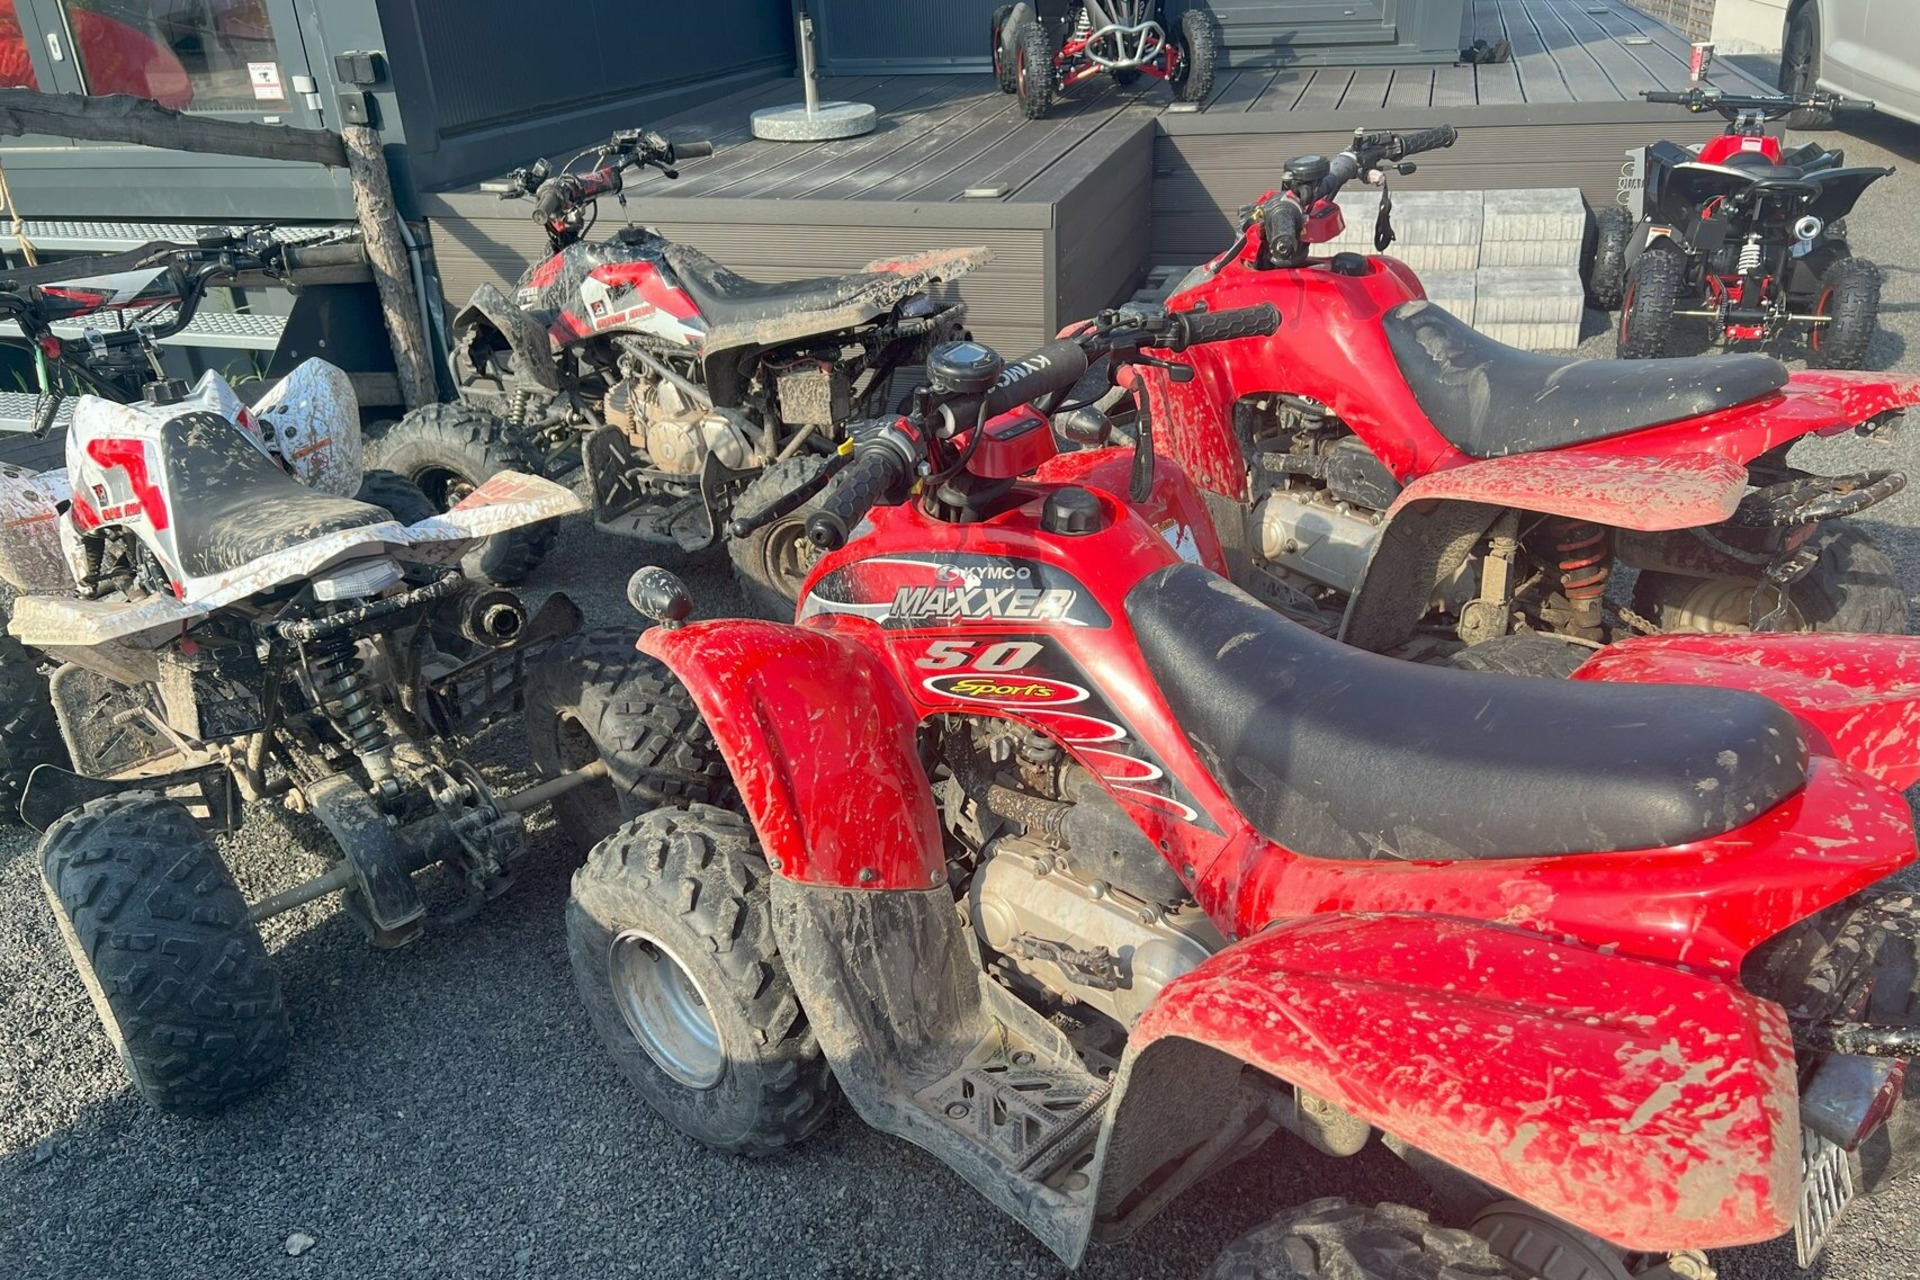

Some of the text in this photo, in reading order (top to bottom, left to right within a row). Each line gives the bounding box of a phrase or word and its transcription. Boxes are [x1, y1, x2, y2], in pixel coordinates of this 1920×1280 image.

[987, 354, 1052, 394] KYMC
[963, 566, 1031, 580] KYMCO
[889, 586, 1077, 619] MAXXER
[914, 640, 1044, 671] 50
[950, 679, 1056, 698] Sports
